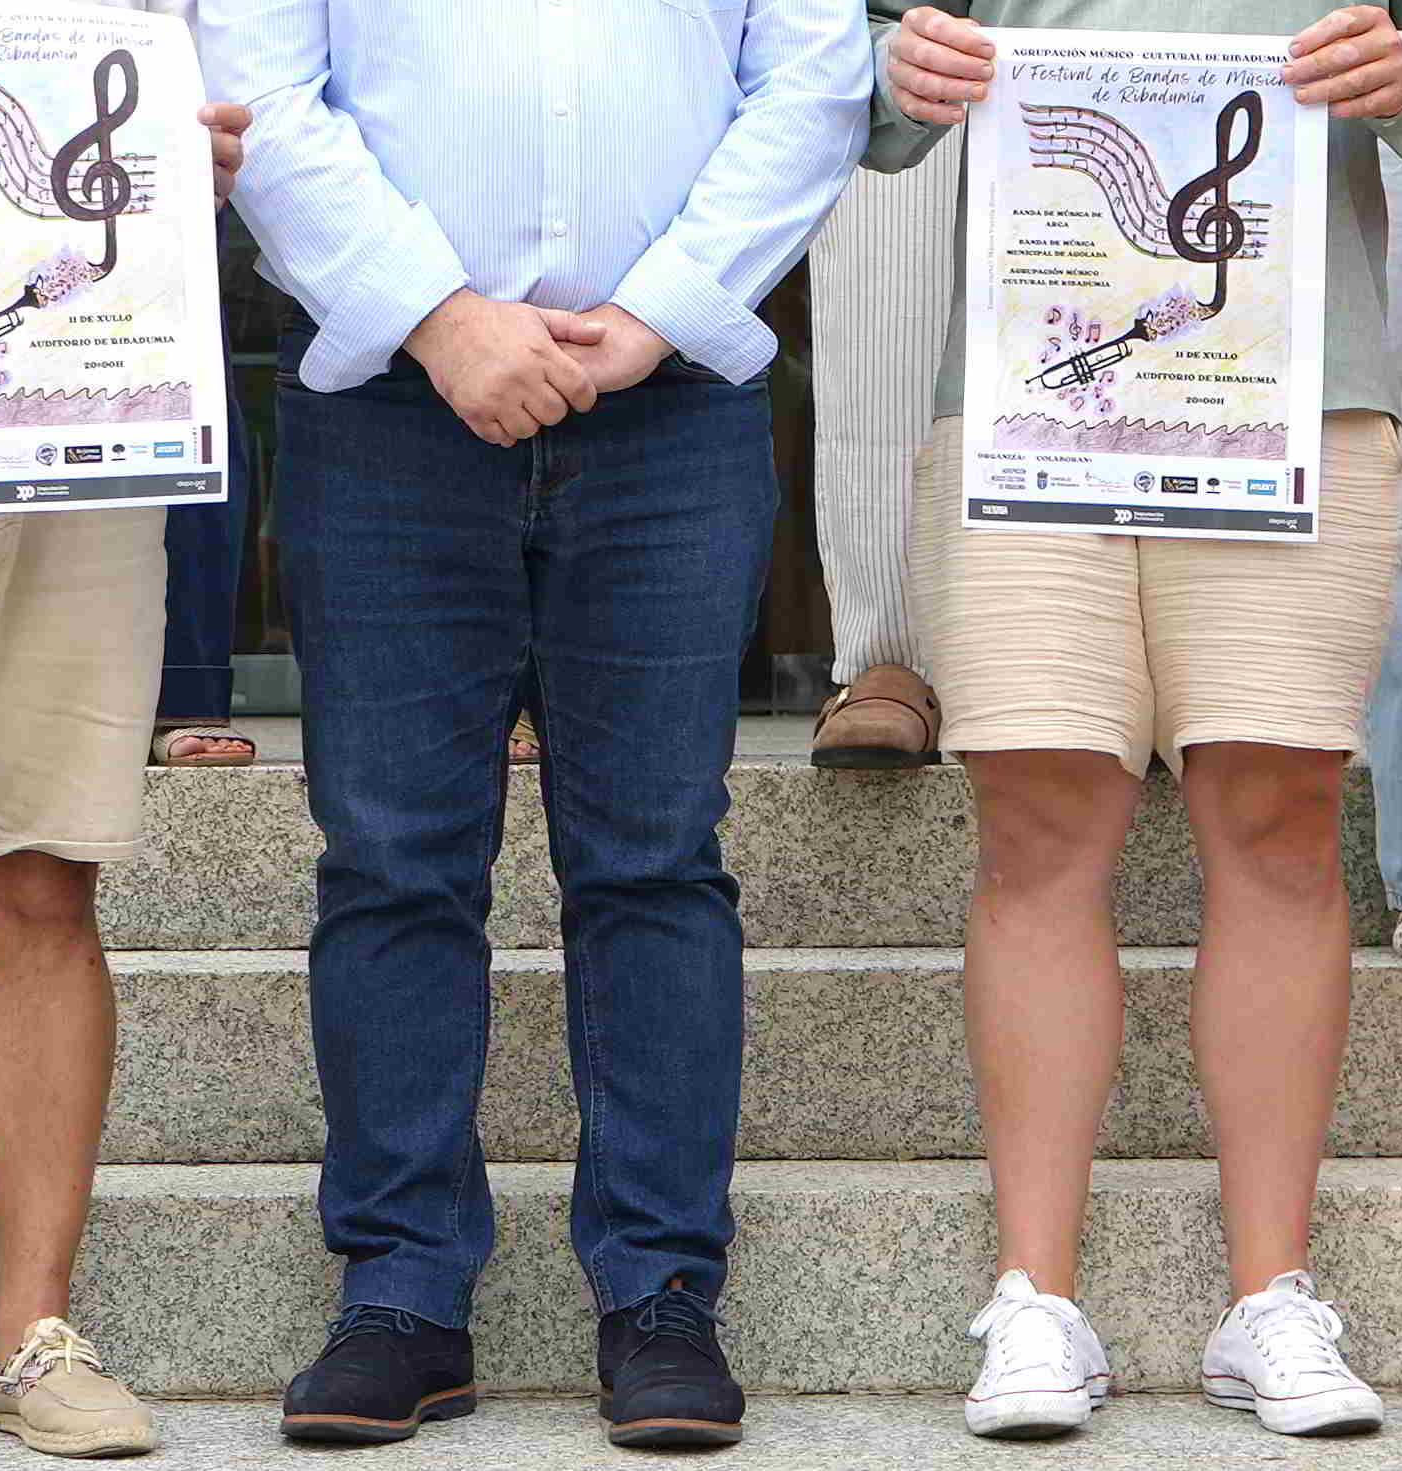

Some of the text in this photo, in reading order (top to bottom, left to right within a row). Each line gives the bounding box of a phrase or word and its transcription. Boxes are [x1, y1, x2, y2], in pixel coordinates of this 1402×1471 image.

[1013, 48, 1086, 57] AGRUPACIÓN
[1089, 48, 1134, 59] MÚSICO
[1142, 52, 1202, 61] CULTURAL
[1205, 54, 1219, 62] DE
[1222, 54, 1288, 63] RIBADUMIA
[1012, 63, 1027, 80] V
[1030, 64, 1093, 83] Festival
[1100, 66, 1120, 83] de
[1128, 66, 1189, 85] Bandas
[1198, 69, 1217, 86] de
[1092, 85, 1205, 104] de Ribadumia
[80, 315, 94, 323] DE
[97, 314, 133, 323] XULLO
[29, 336, 175, 348] AUDITORIO DE RIBADUMIA
[1175, 350, 1238, 360] 11 DE XULLO
[1135, 372, 1277, 384] AUDITORIO DE RIBADUMIA
